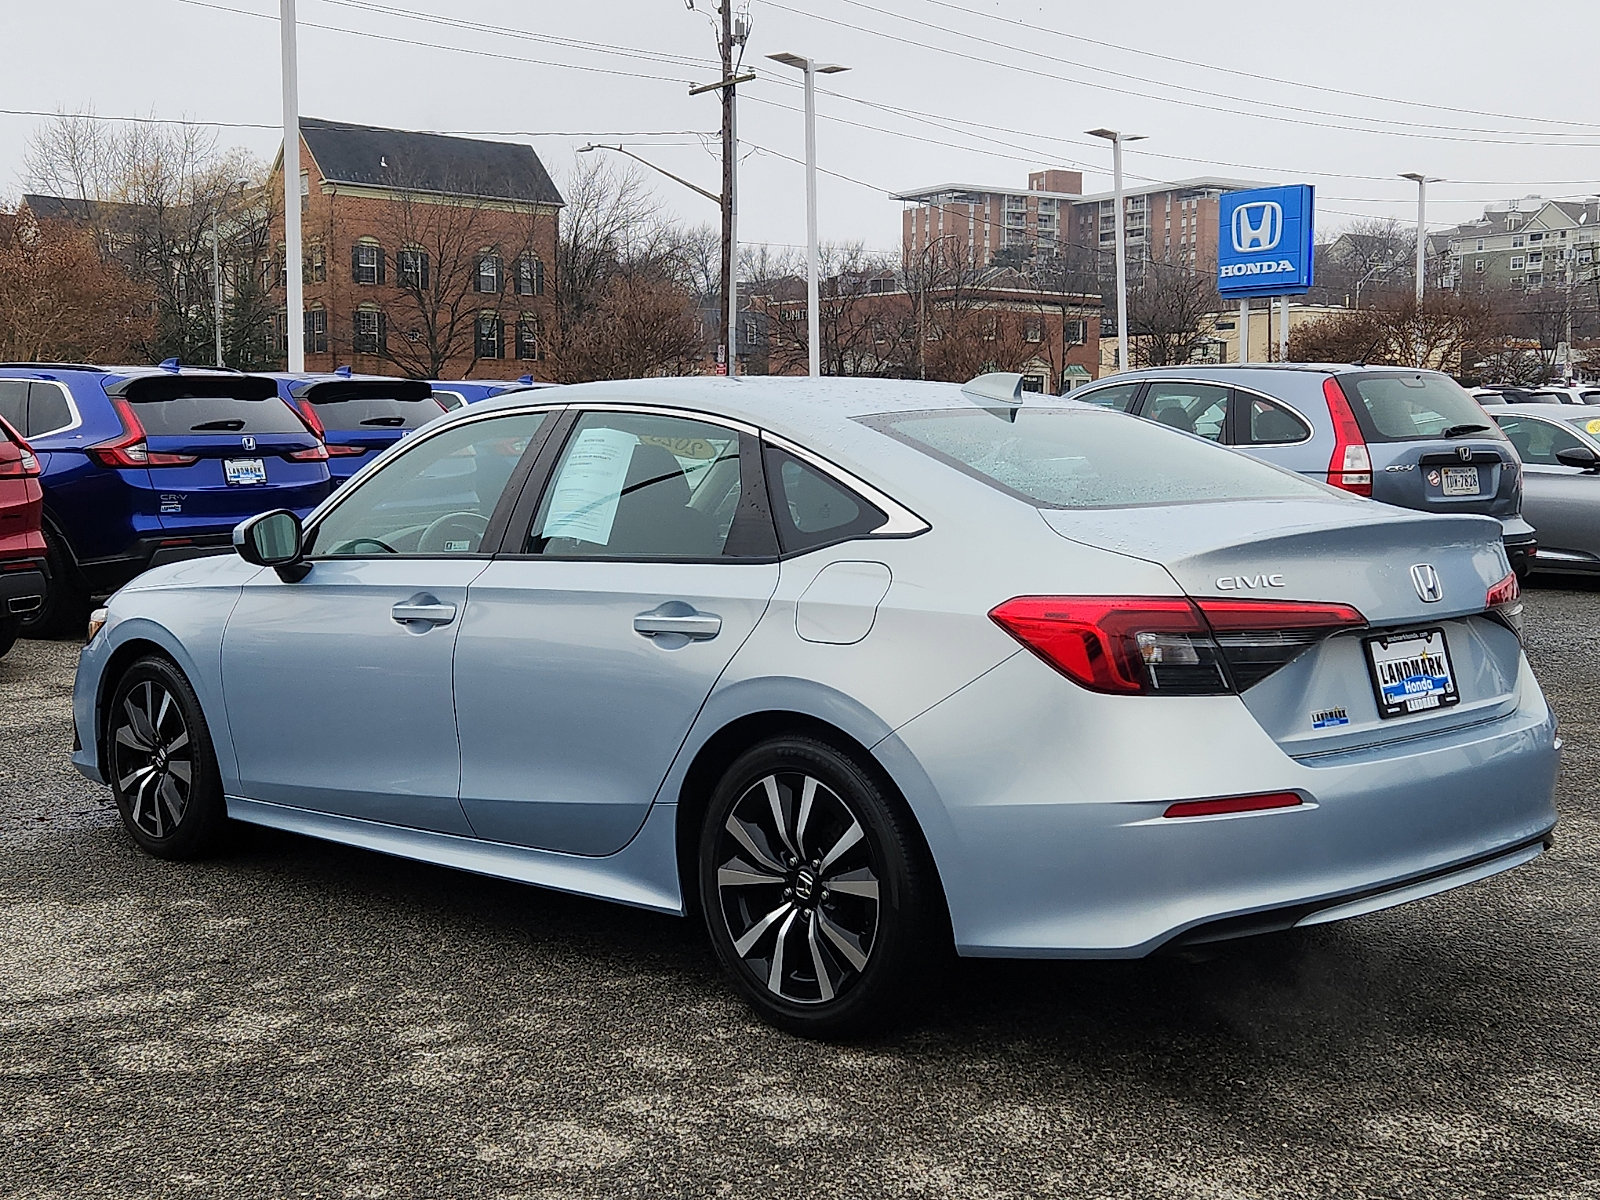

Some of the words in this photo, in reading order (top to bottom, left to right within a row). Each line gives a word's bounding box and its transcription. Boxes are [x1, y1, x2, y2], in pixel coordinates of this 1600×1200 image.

[1219, 259, 1296, 278] HONDA
[228, 467, 262, 475] LANDMARK
[1215, 573, 1286, 591] CIVIC
[1380, 656, 1445, 684] LANDMARK
[1404, 678, 1434, 694] Honda
[1408, 697, 1438, 710] LANDMARK
[1312, 709, 1347, 722] LANDMARK
